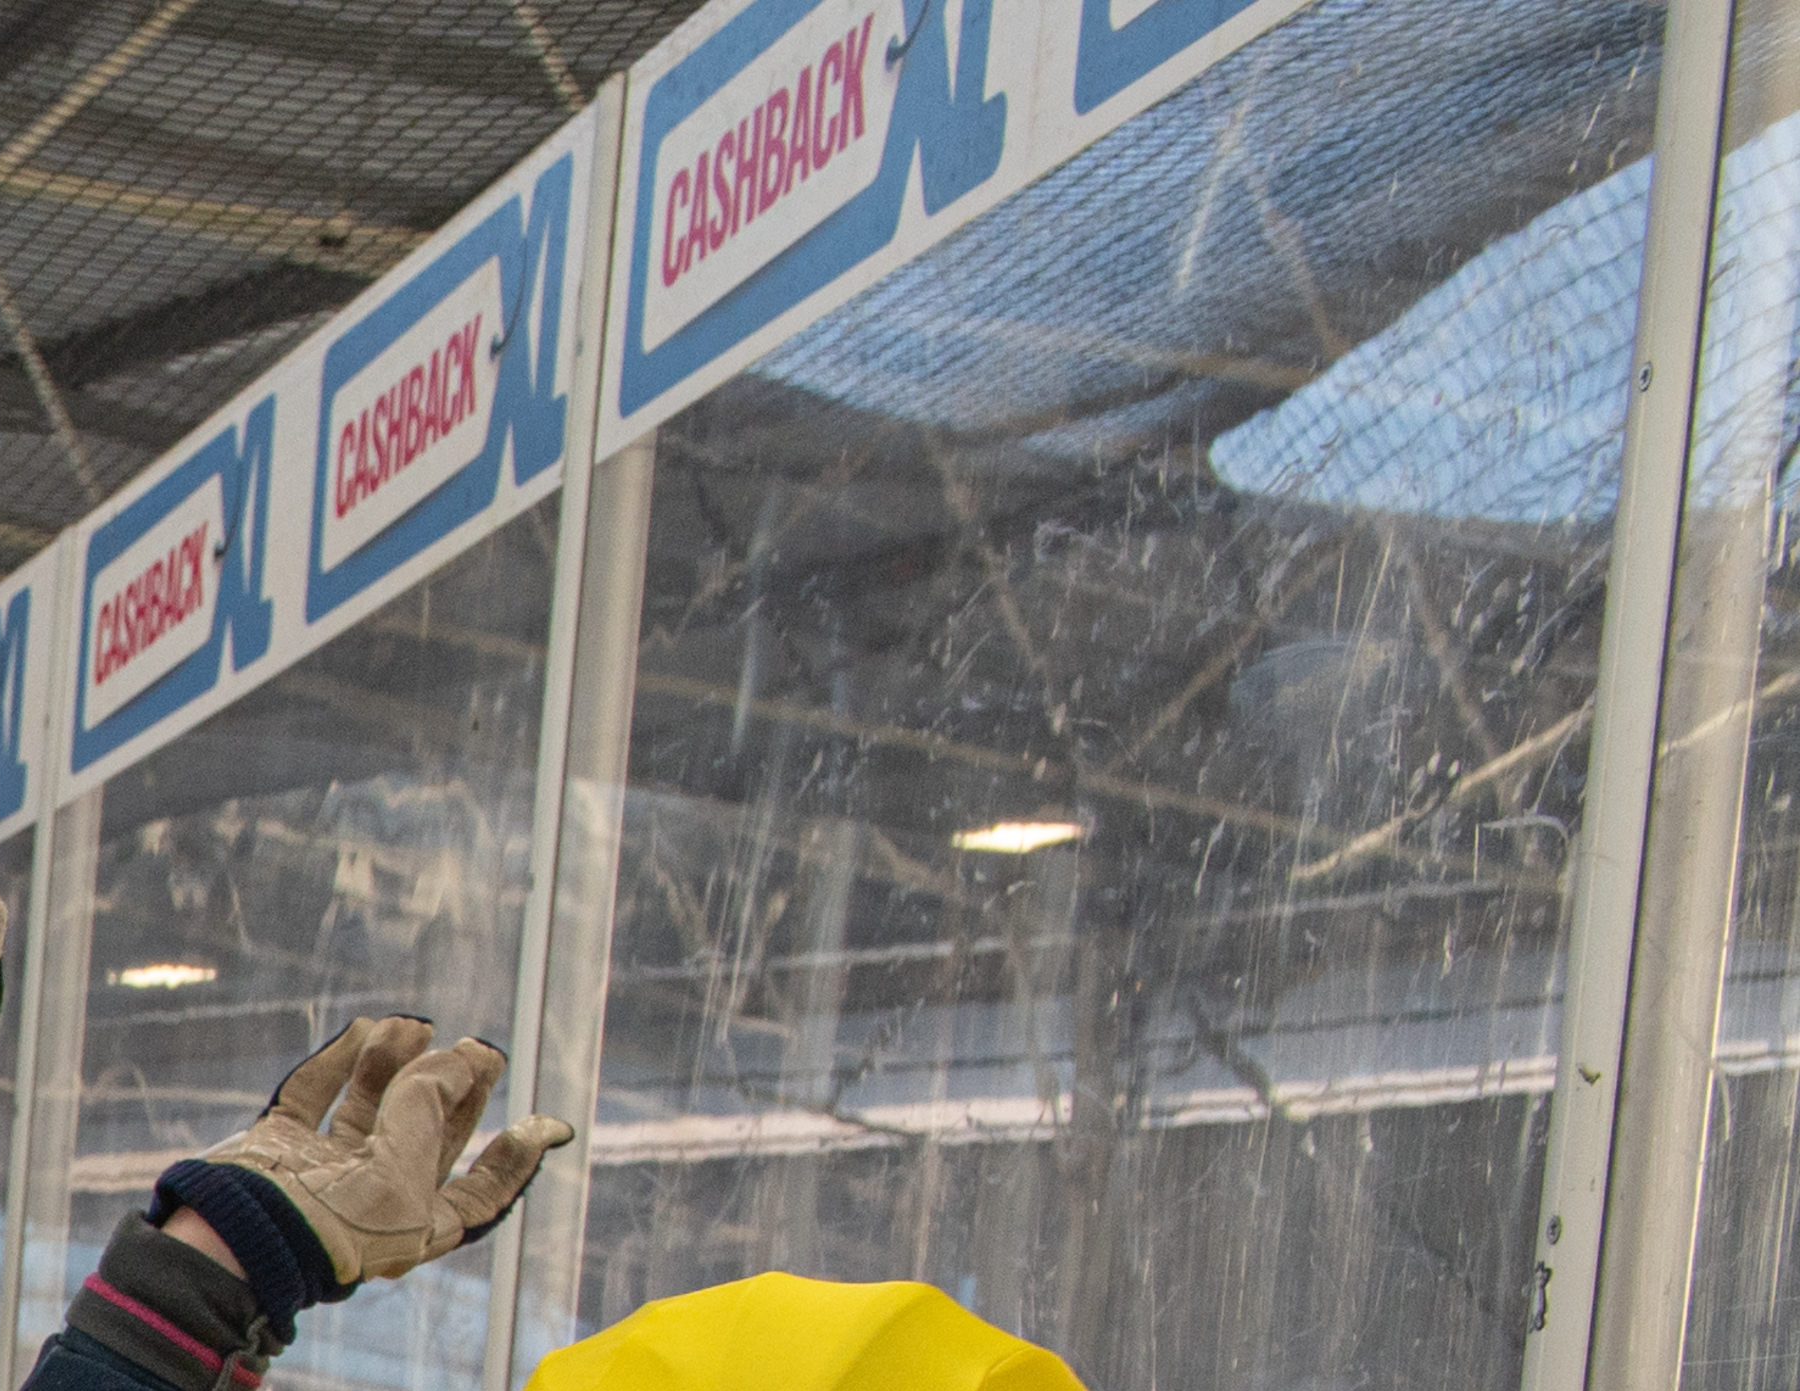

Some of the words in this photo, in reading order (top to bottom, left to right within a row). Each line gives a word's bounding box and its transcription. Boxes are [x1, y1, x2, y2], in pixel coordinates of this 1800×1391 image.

[662, 11, 874, 289] CASHBACK
[336, 313, 483, 519] CASHBACK
[95, 520, 209, 686] CASHBACK
